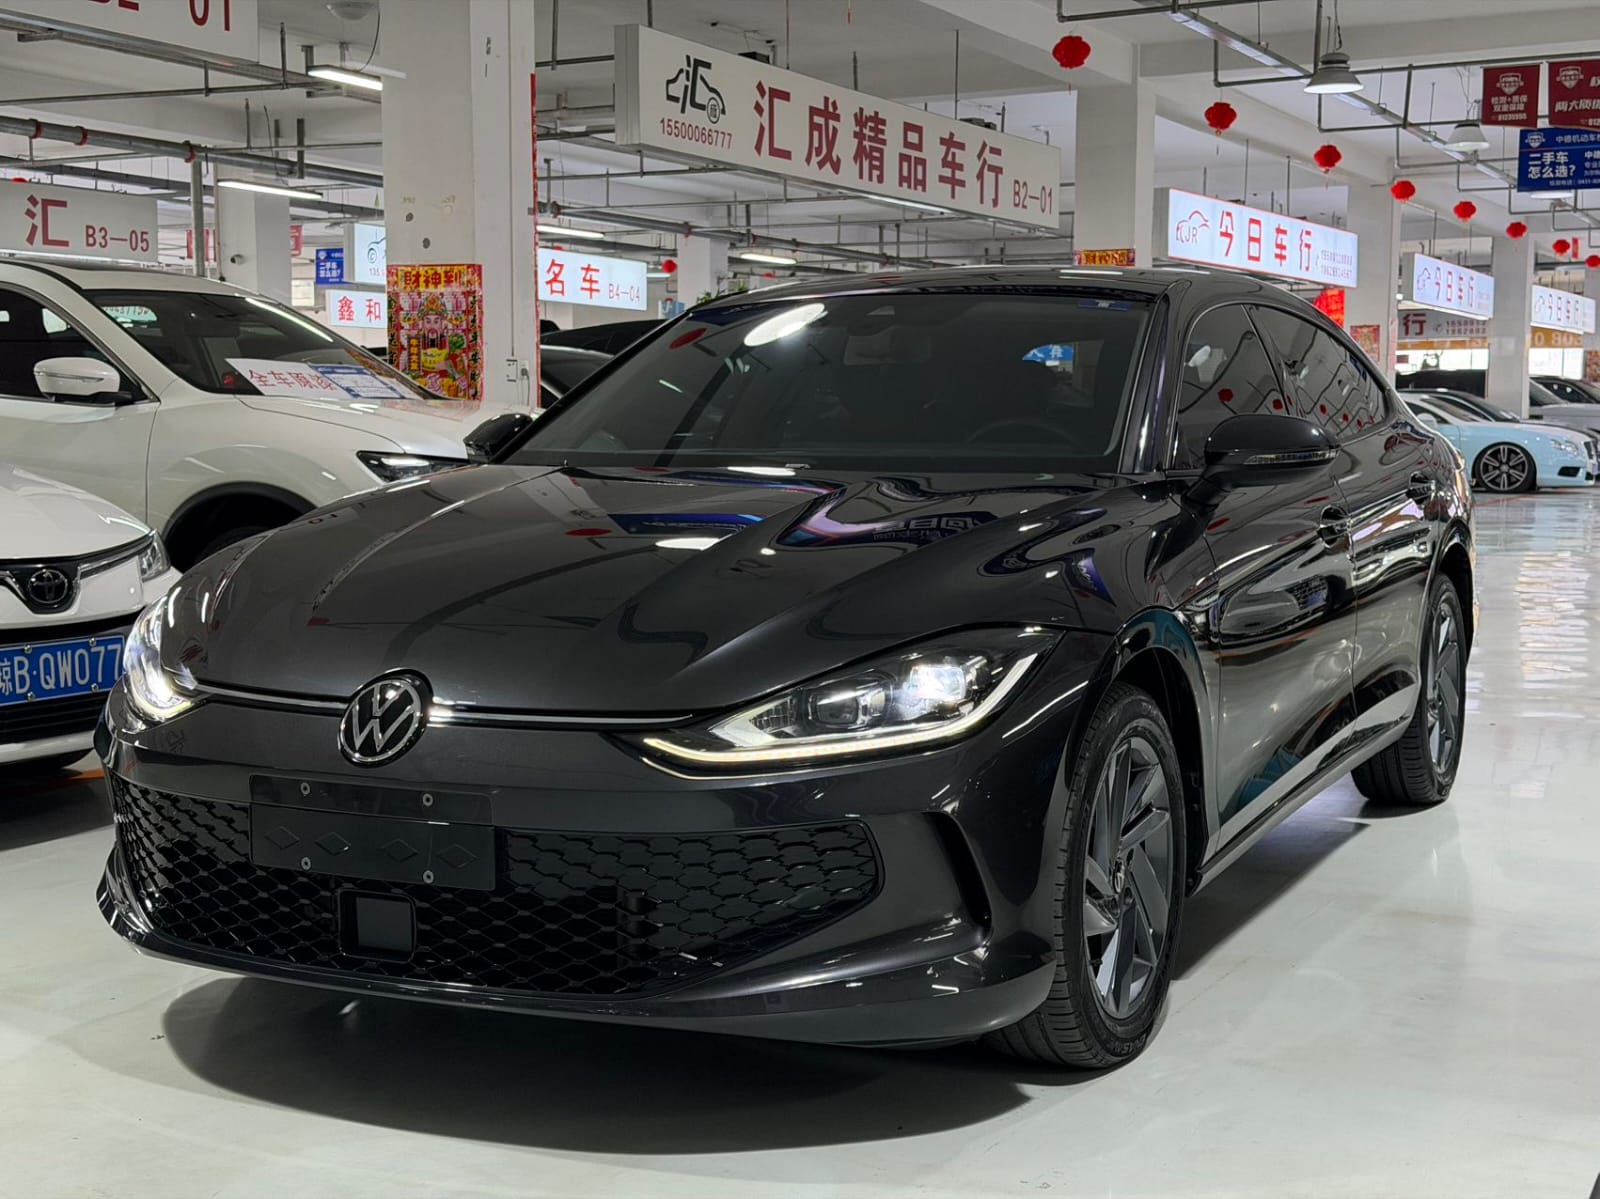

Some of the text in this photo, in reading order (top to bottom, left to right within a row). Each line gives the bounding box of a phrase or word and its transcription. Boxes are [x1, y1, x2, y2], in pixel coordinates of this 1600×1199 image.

[660, 117, 733, 149] 15500066777
[753, 80, 1004, 209] 汇成精品车行
[1528, 151, 1569, 165] 二手车
[24, 194, 69, 247] 汇
[1219, 209, 1312, 272] 今日车行
[545, 258, 601, 300] 名车
[1435, 265, 1475, 308] 今日车行
[338, 295, 382, 322] 鑫和
[1403, 313, 1427, 336] 行
